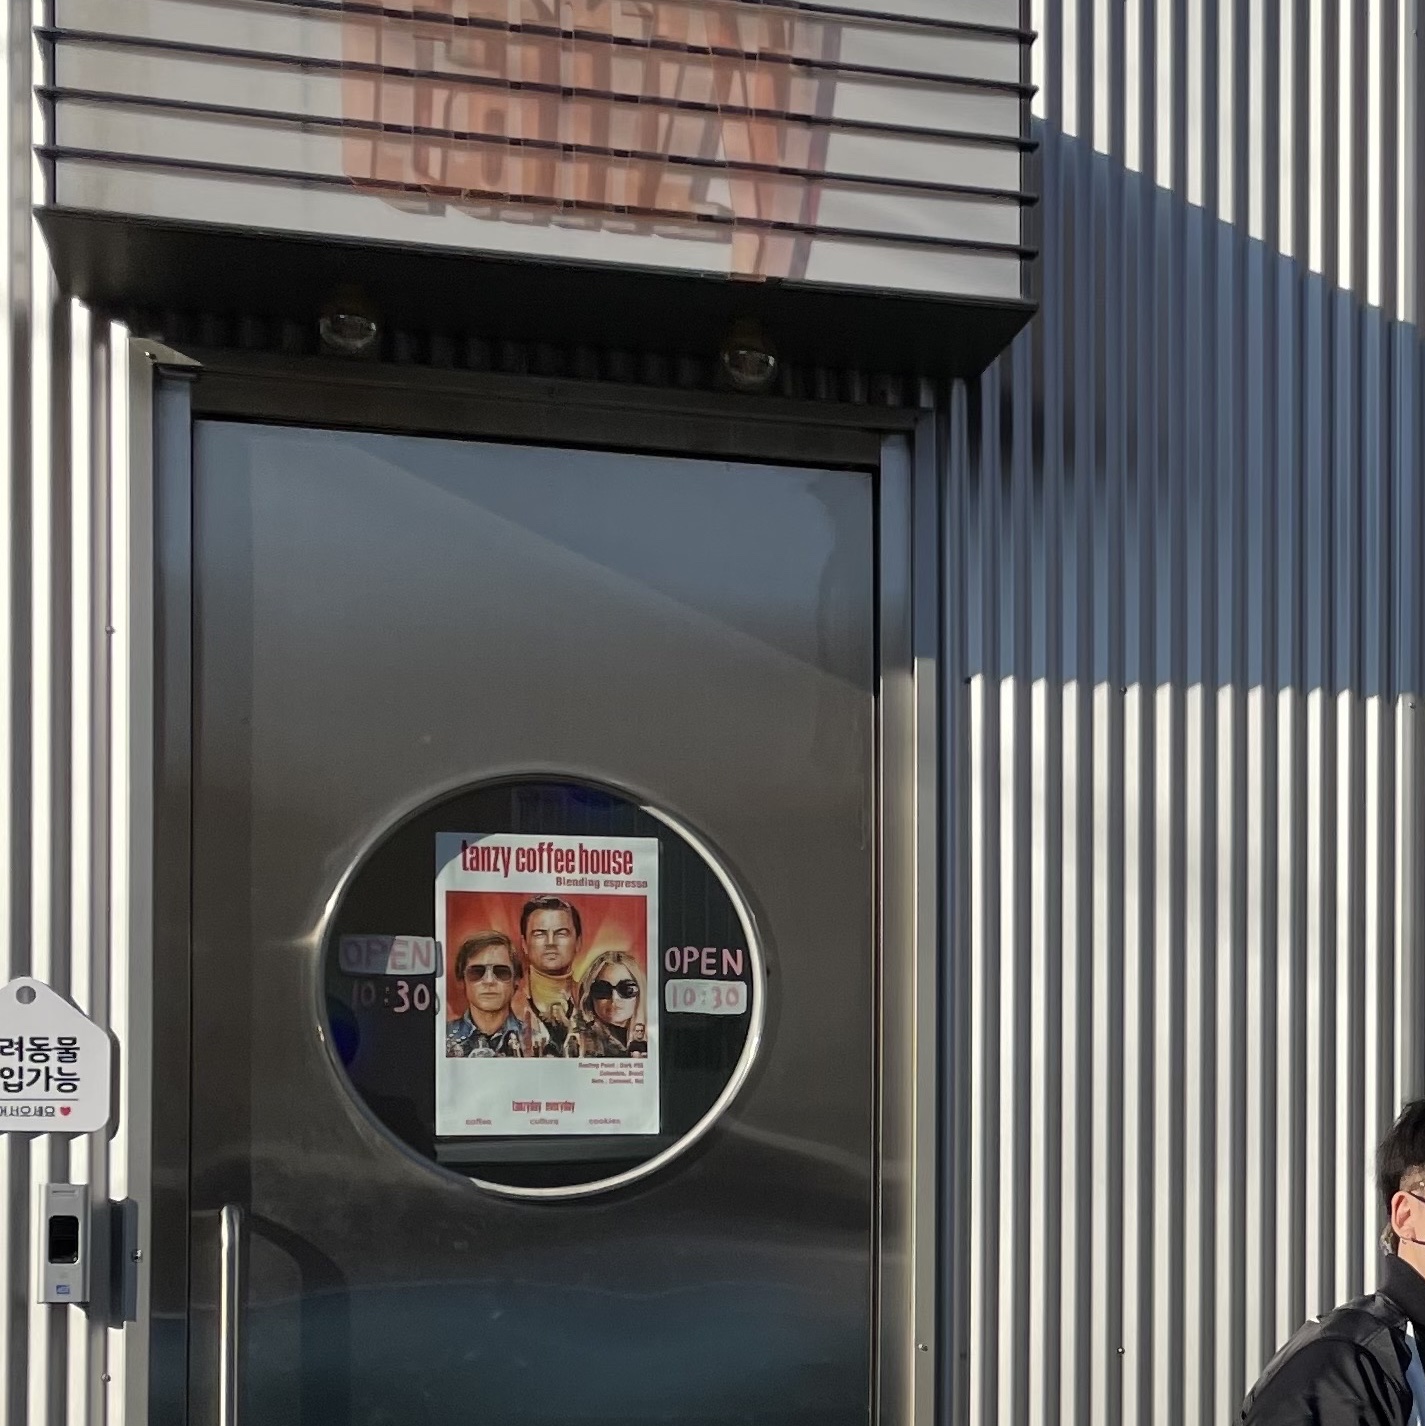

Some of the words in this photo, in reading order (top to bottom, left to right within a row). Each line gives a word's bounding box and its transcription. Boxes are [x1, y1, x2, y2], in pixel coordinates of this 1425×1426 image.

[461, 840, 511, 878] tanzy
[515, 842, 575, 873] coffee
[578, 843, 633, 875] house
[555, 876, 600, 889] Blending
[603, 878, 648, 889] espresso
[665, 946, 743, 976] OPEN
